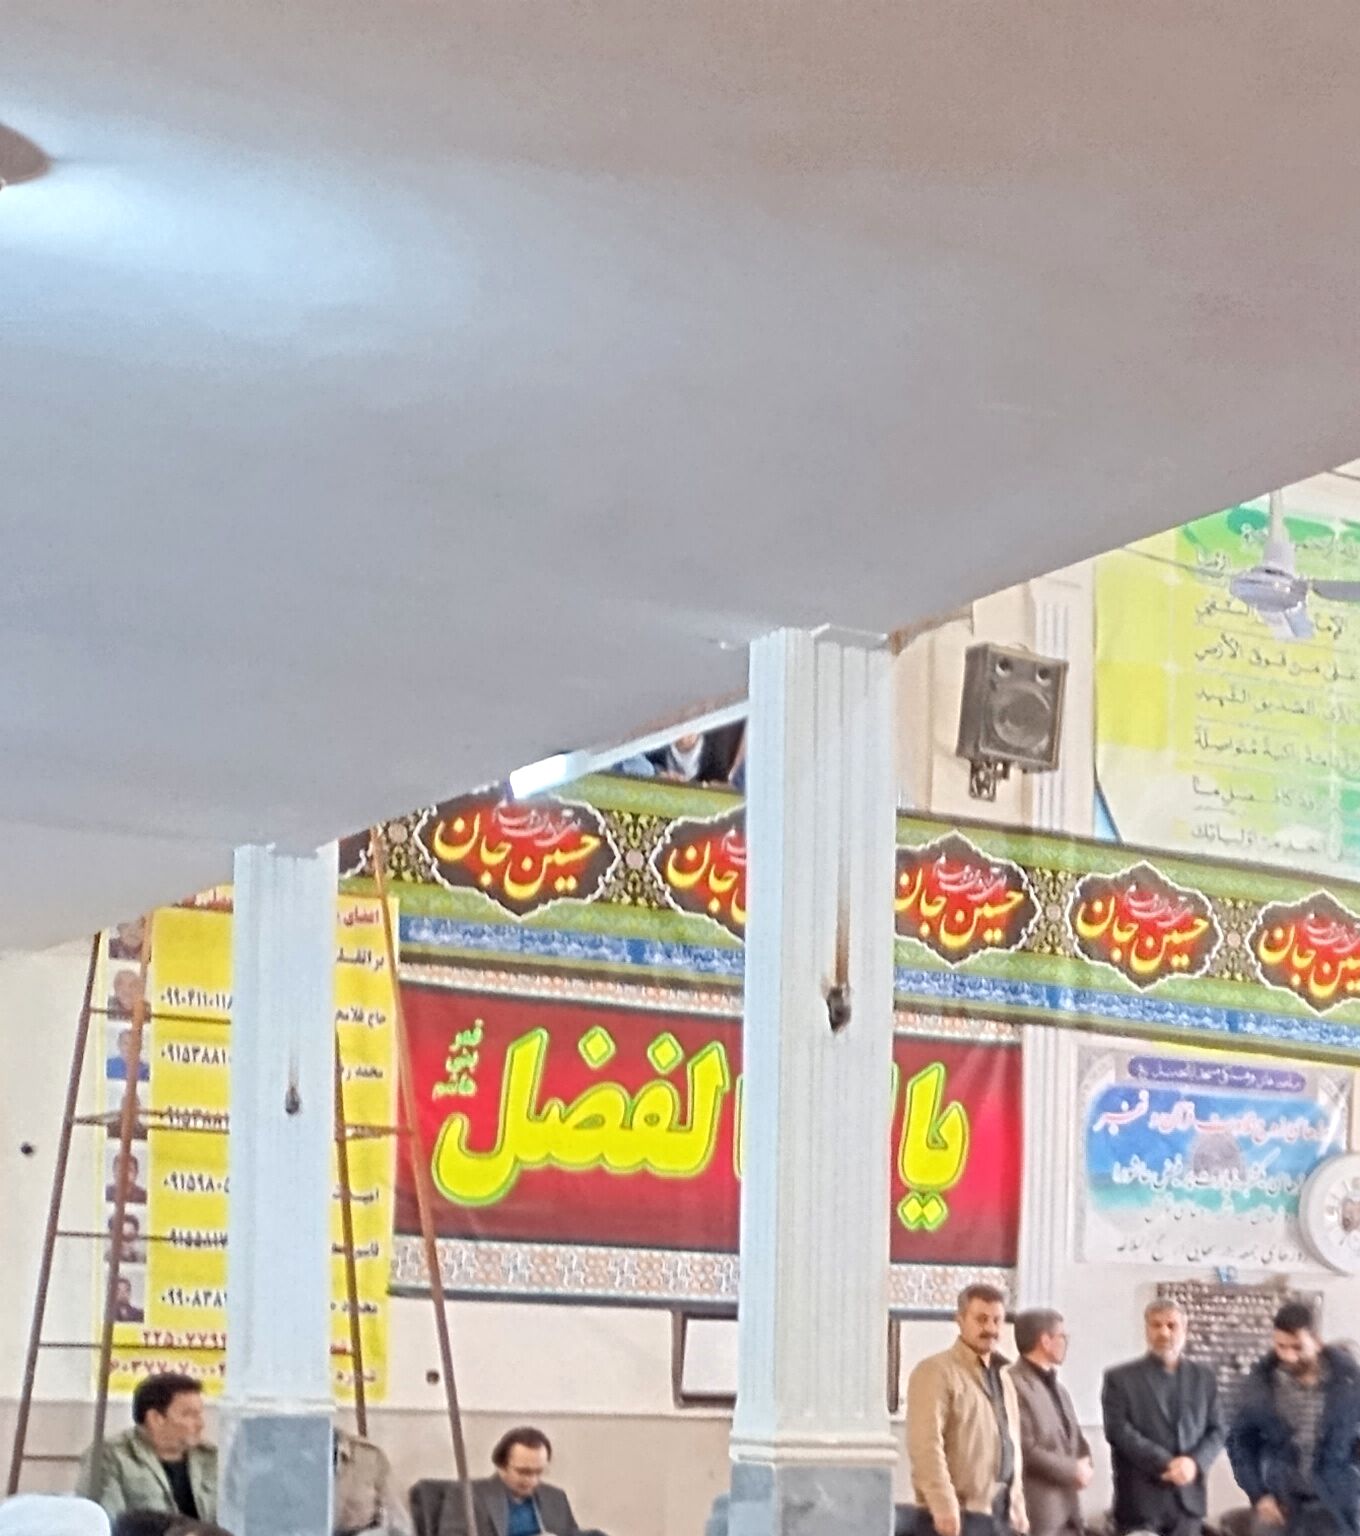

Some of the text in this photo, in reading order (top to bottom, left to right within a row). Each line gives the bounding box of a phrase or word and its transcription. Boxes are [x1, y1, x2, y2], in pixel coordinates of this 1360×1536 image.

[432, 811, 512, 887] جان
[503, 833, 601, 900] حسین
[666, 840, 739, 914] جان
[939, 889, 1025, 949] حسین
[1075, 896, 1139, 962] جان
[1129, 915, 1209, 974] حسین
[1258, 924, 1317, 987] جان
[898, 1061, 971, 1232] یا
